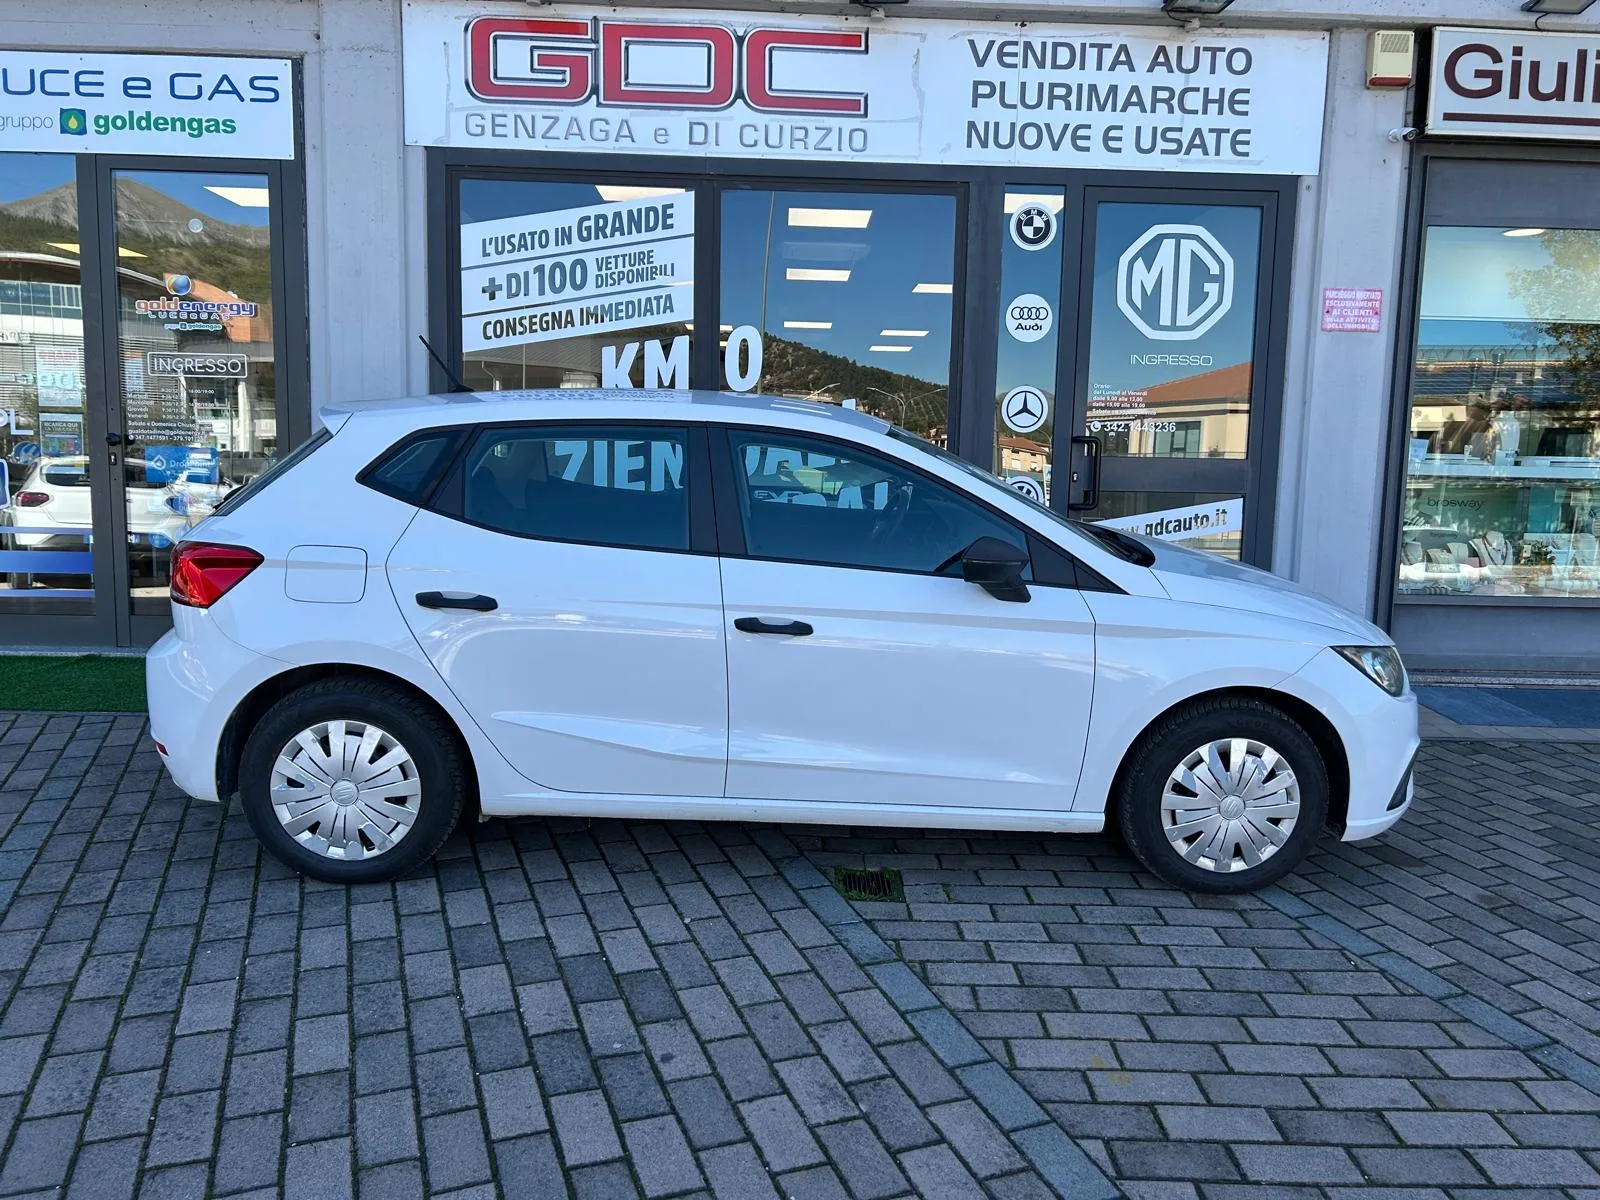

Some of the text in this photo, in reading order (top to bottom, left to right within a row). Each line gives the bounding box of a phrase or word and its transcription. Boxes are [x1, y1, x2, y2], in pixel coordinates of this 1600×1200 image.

[465, 16, 868, 117] GDC
[968, 39, 1252, 75] VENDITA AUTO
[2, 68, 280, 103] UCE e GAS
[971, 80, 1251, 116] PLURIMARCHE
[93, 110, 237, 139] goldengas
[465, 112, 868, 152] GENZAGA e DI CURZIO
[966, 120, 1251, 157] NUOVE E USATE
[1020, 209, 1048, 221] BMW
[481, 203, 674, 257] L'USATO IN GRANDE
[596, 250, 655, 272] VETTURE
[595, 263, 675, 289] DISPONIBILI
[1132, 238, 1220, 326] MG
[135, 296, 256, 317] goldenergy
[148, 311, 187, 319] LUCE
[200, 312, 231, 321] GAS
[483, 294, 675, 340] CONSEGNA IMMEDIATA
[1014, 322, 1043, 331] Audi
[154, 357, 241, 373] INGRESSO
[601, 325, 764, 392] KM 0
[1130, 354, 1212, 366] INGRESSO
[1104, 421, 1176, 432] 342.1443236
[1427, 496, 1484, 511] brosway
